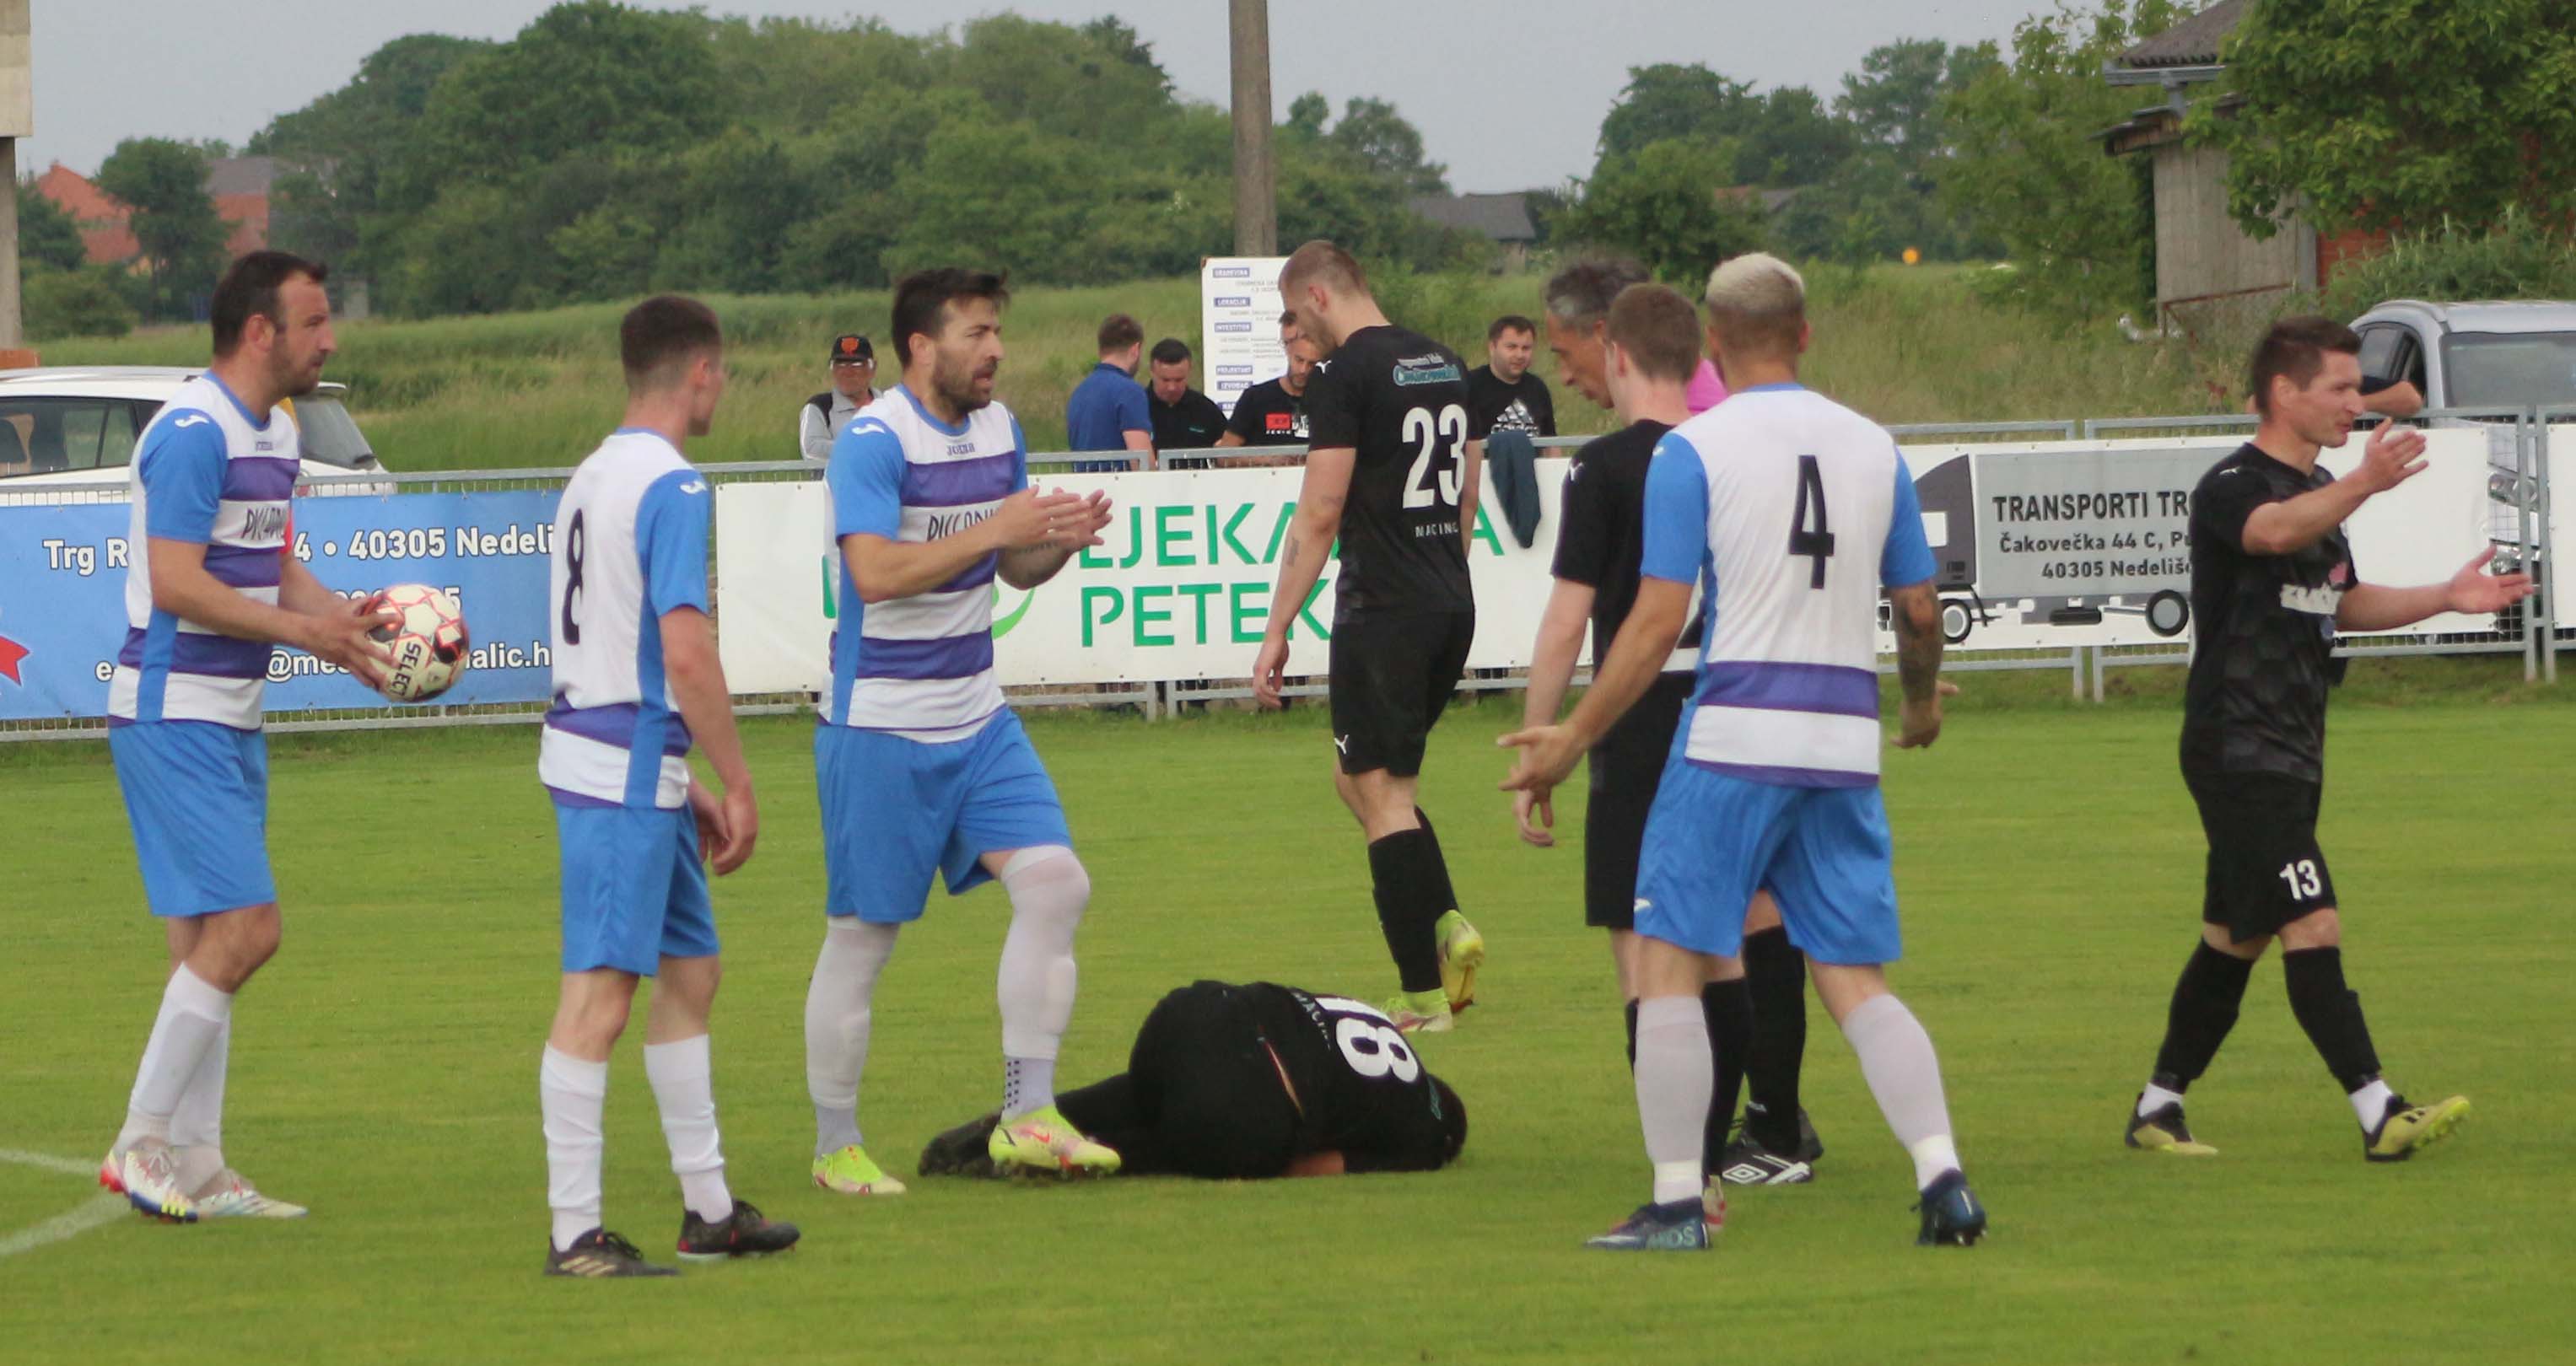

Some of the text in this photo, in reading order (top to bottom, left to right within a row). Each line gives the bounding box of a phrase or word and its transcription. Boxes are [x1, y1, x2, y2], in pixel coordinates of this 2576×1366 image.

[1402, 404, 1468, 508] 23
[1789, 454, 1835, 589] 4
[1992, 491, 2193, 522] TRANSPORTI TR
[43, 538, 95, 577] Trg
[348, 527, 445, 560] 40305
[455, 524, 554, 557] Nedeli
[2000, 531, 2105, 553] Čakovečka
[2111, 533, 2137, 549] 44
[2144, 532, 2163, 552] C,
[561, 508, 584, 646] 8
[2042, 561, 2104, 578] 40305
[1081, 578, 1331, 648] PETEK
[2280, 858, 2321, 900] 13
